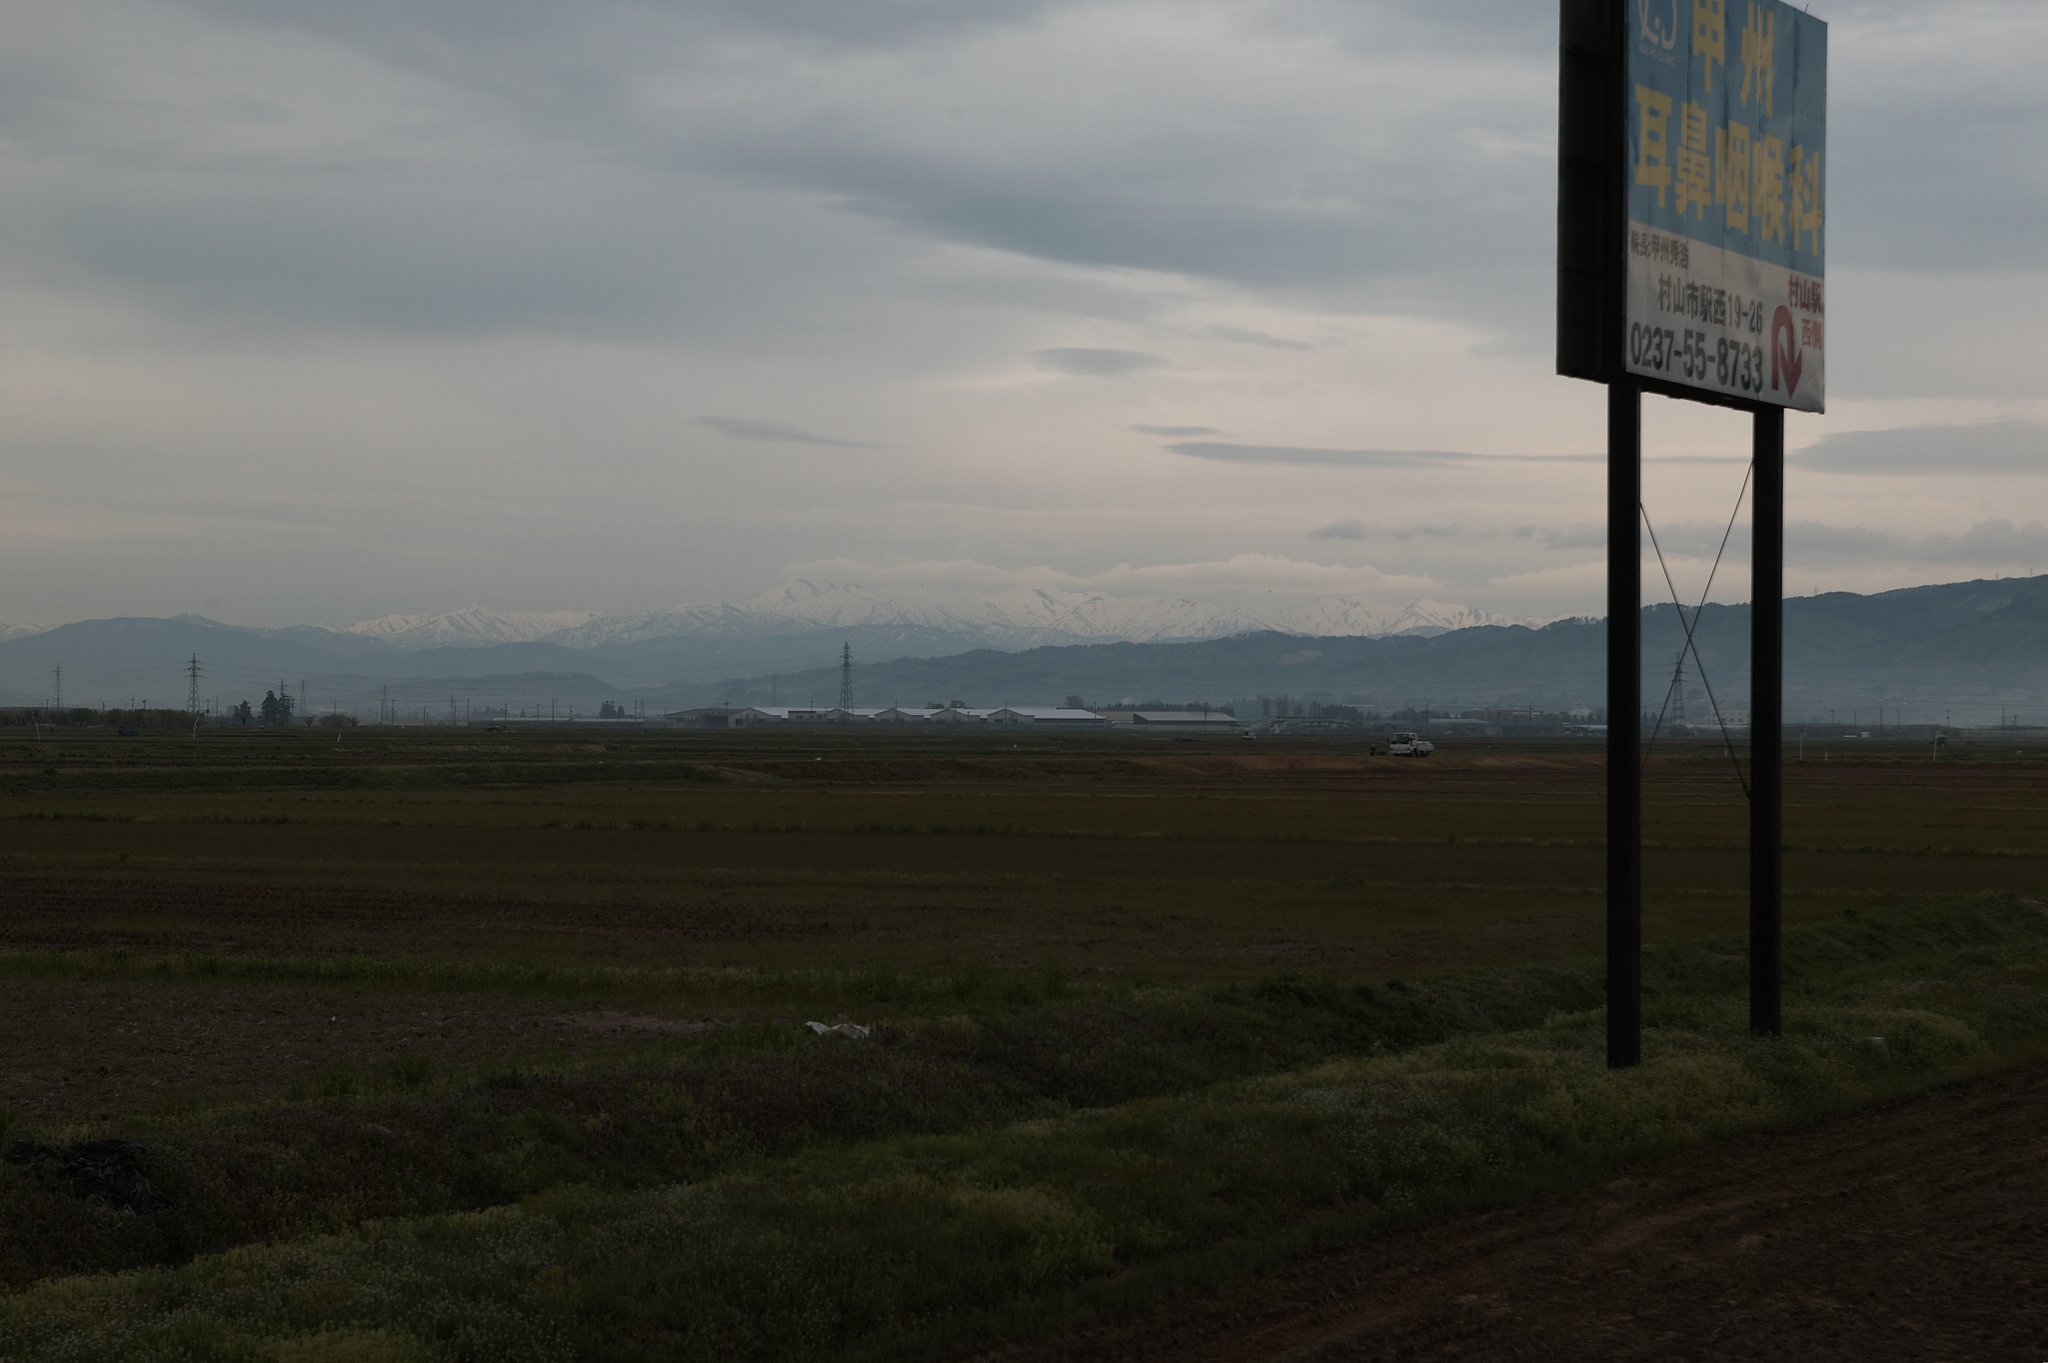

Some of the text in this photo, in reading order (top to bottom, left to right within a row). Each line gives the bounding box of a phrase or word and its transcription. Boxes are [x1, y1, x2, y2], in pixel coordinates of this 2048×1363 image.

[1693, 0, 1773, 119] 甲州
[1634, 84, 1822, 257] 耳鼻咽喉科
[1787, 274, 1823, 314] 村山駅
[1630, 321, 1763, 394] 0237-55-8733
